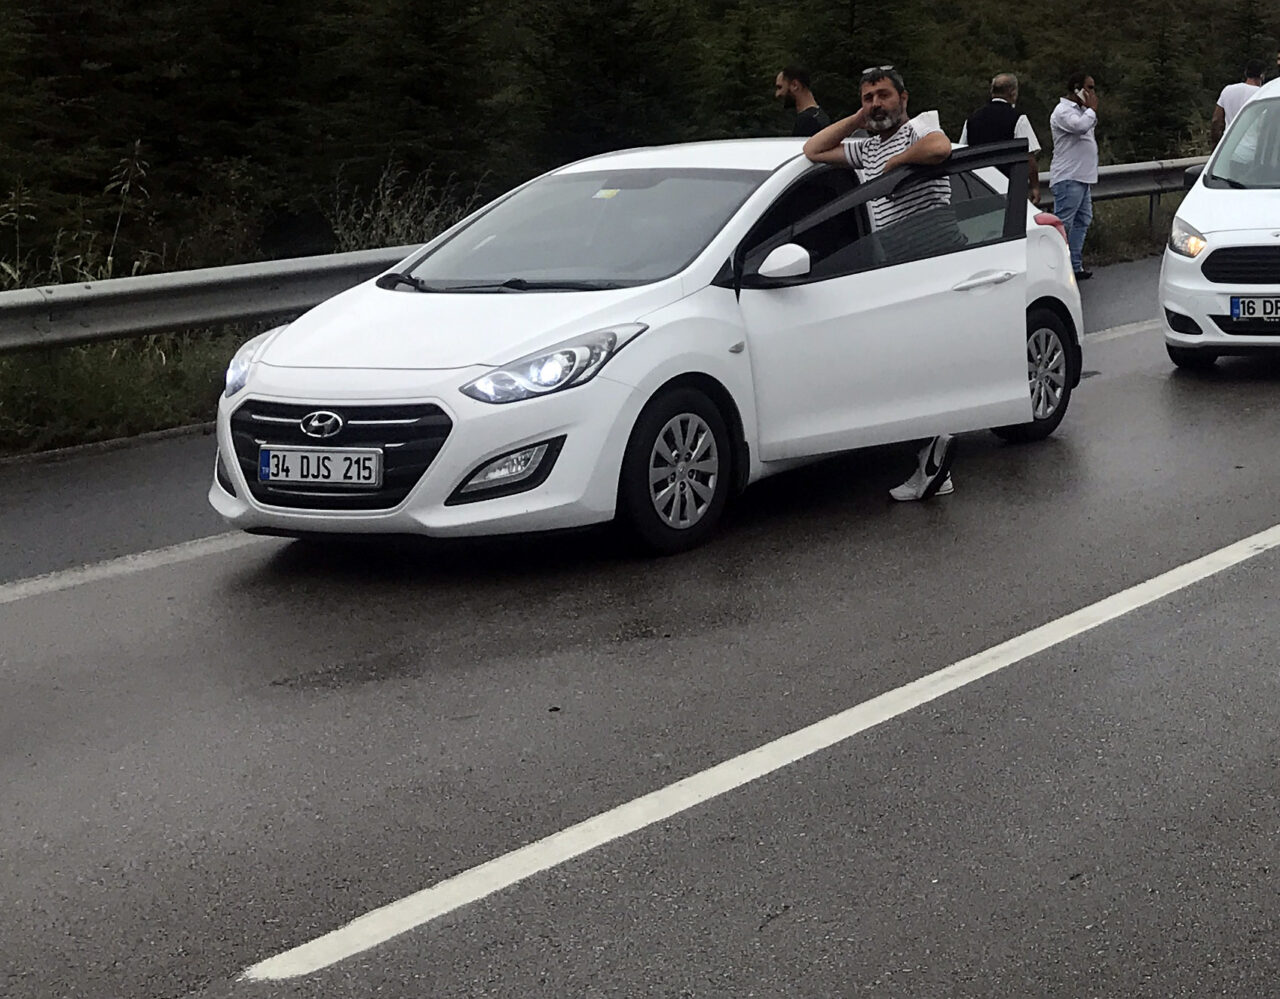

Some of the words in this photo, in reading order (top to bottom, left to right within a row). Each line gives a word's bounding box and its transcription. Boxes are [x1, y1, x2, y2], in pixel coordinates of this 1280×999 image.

[1240, 300, 1256, 316] 16
[271, 454, 290, 477] 34
[301, 455, 332, 479] DJS
[343, 456, 372, 481] 215
